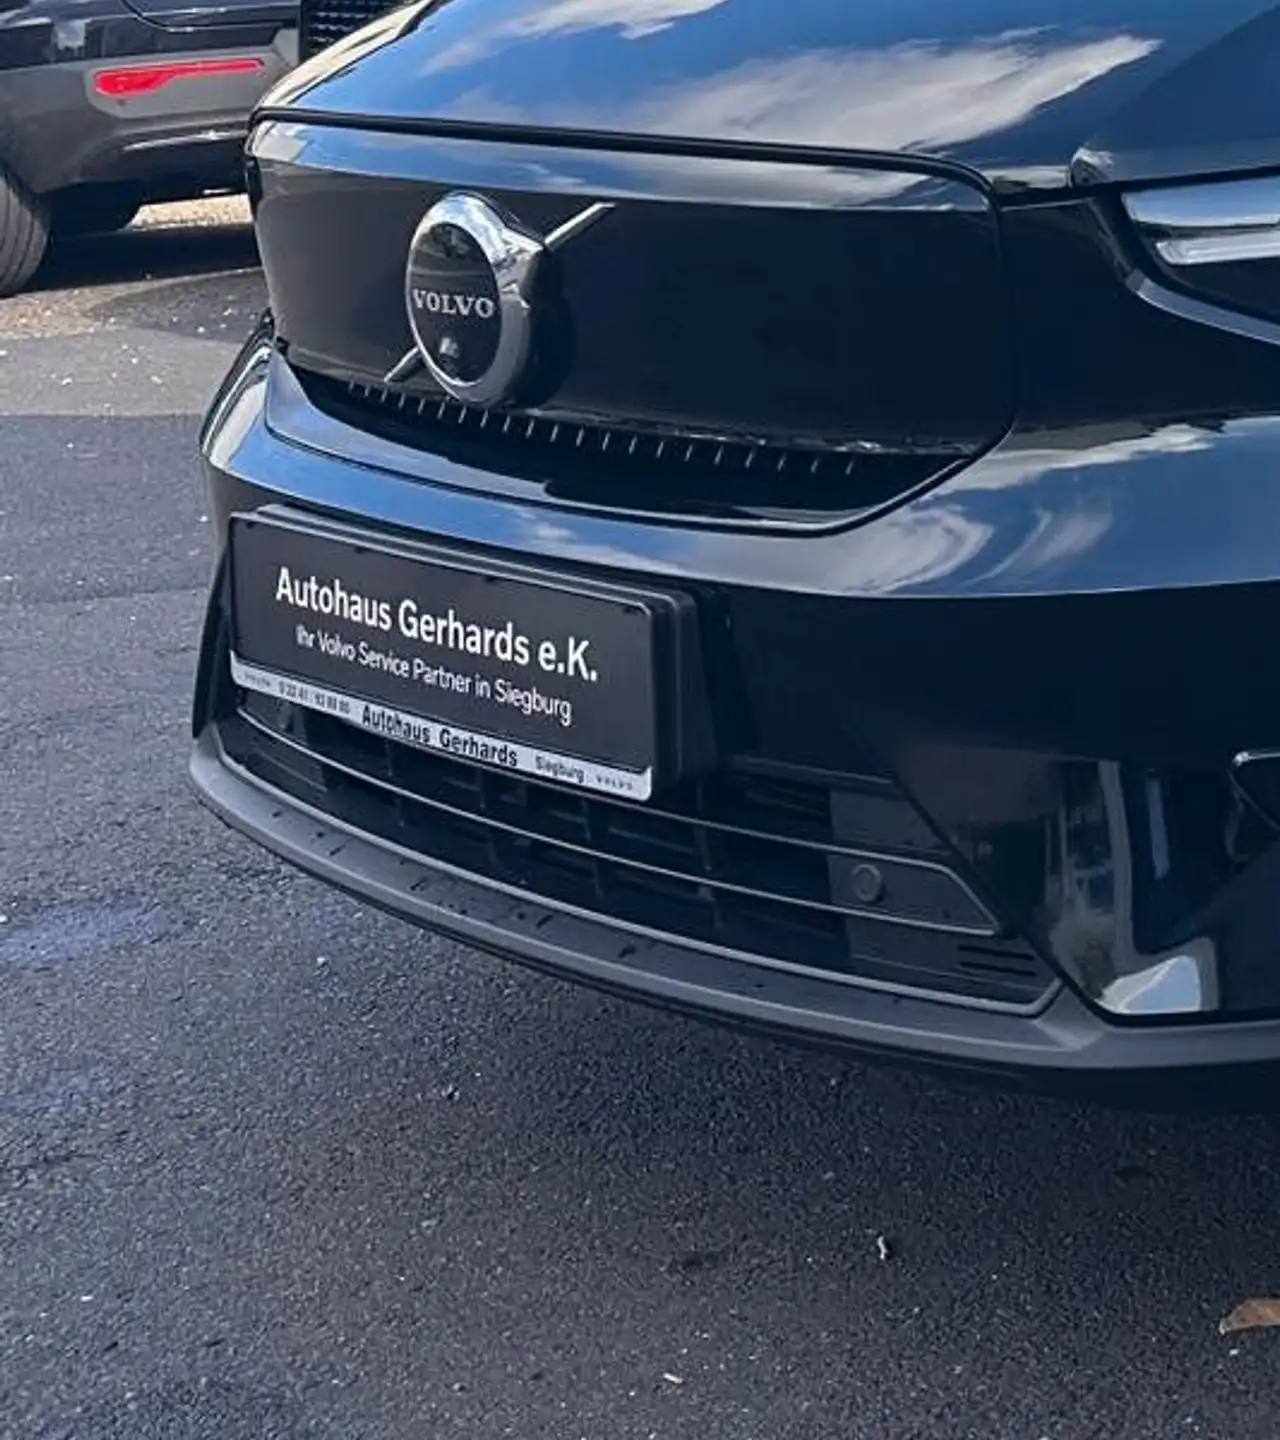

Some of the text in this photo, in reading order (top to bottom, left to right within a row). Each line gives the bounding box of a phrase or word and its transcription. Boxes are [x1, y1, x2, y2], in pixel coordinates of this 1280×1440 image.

[412, 288, 495, 318] VOLVO
[275, 566, 599, 682] Autohaus Gerhards e.K.
[296, 624, 573, 727] Ihr Volvo Service Partner in Siegburg
[361, 703, 431, 744] Autohaus
[438, 728, 519, 768] Gerhards
[534, 754, 585, 784] Siegburg
